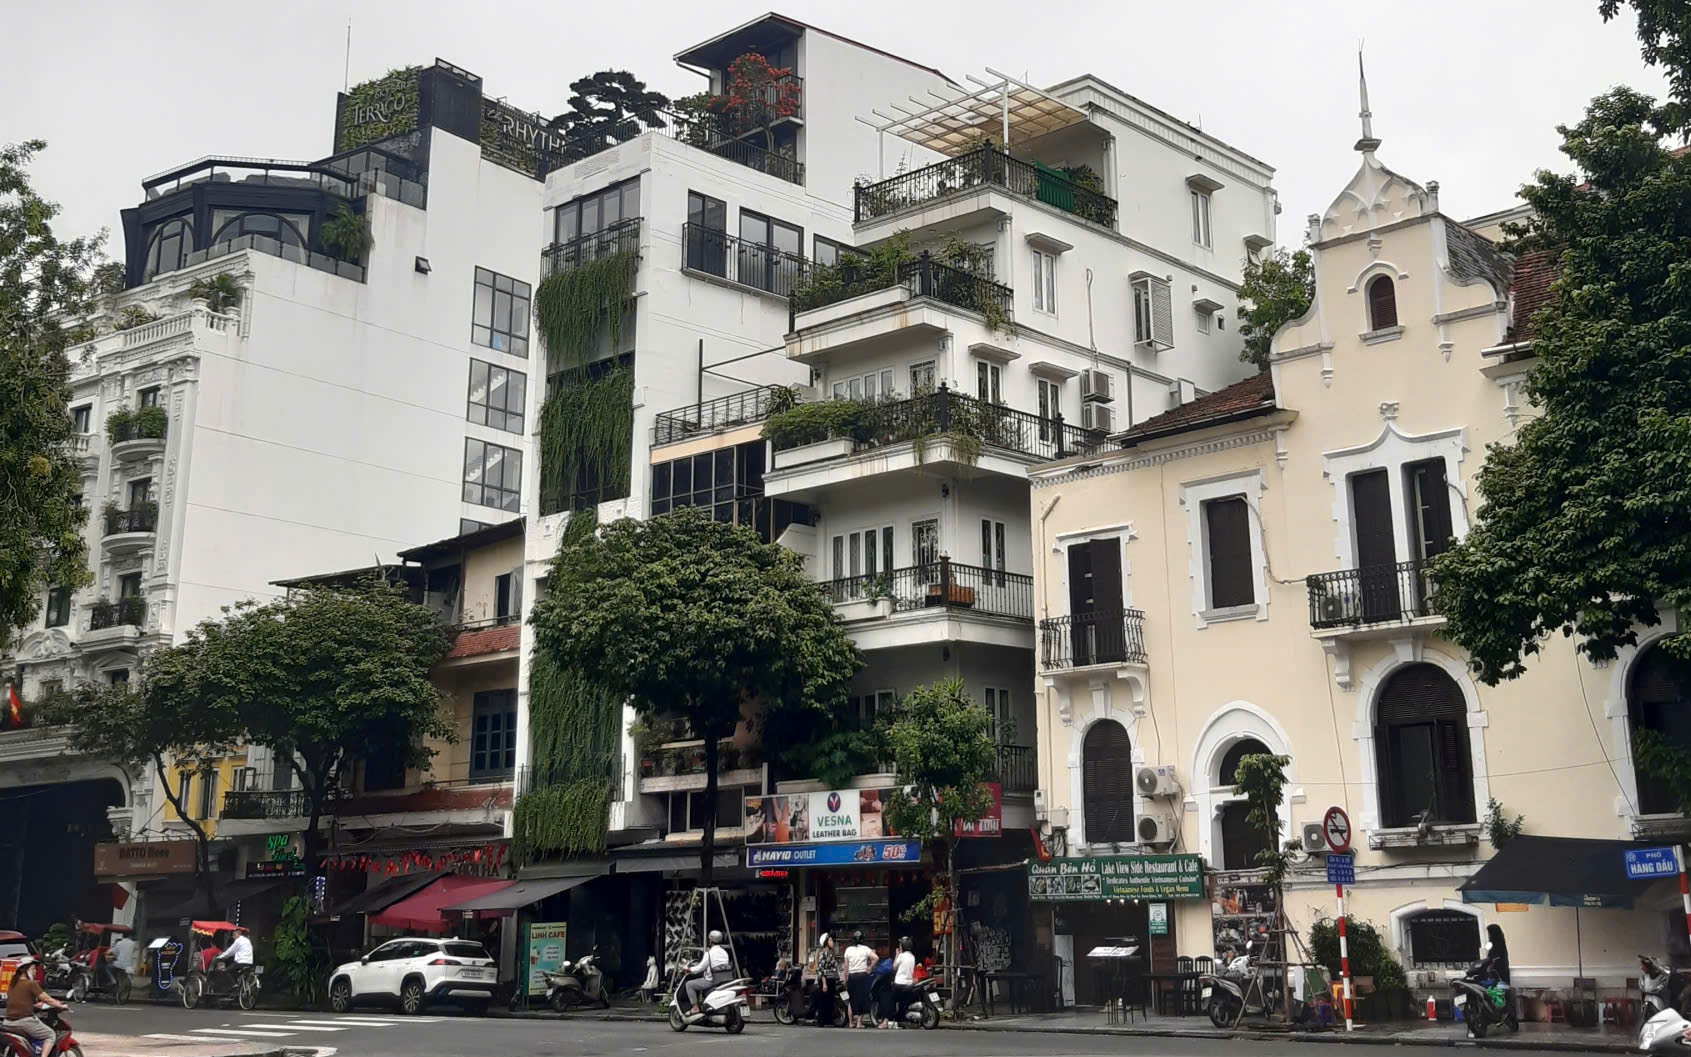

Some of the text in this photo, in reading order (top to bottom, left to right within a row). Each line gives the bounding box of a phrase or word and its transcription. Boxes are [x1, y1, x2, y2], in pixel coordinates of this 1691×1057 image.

[816, 815, 853, 827] VESNA
[812, 829, 857, 839] LEATHER BAG
[793, 849, 817, 859] OUTLET
[1101, 861, 1116, 875] Lake
[1116, 861, 1130, 874] View
[1130, 860, 1144, 874] Side
[1144, 860, 1177, 874] Restaurant
[1178, 859, 1184, 872] &
